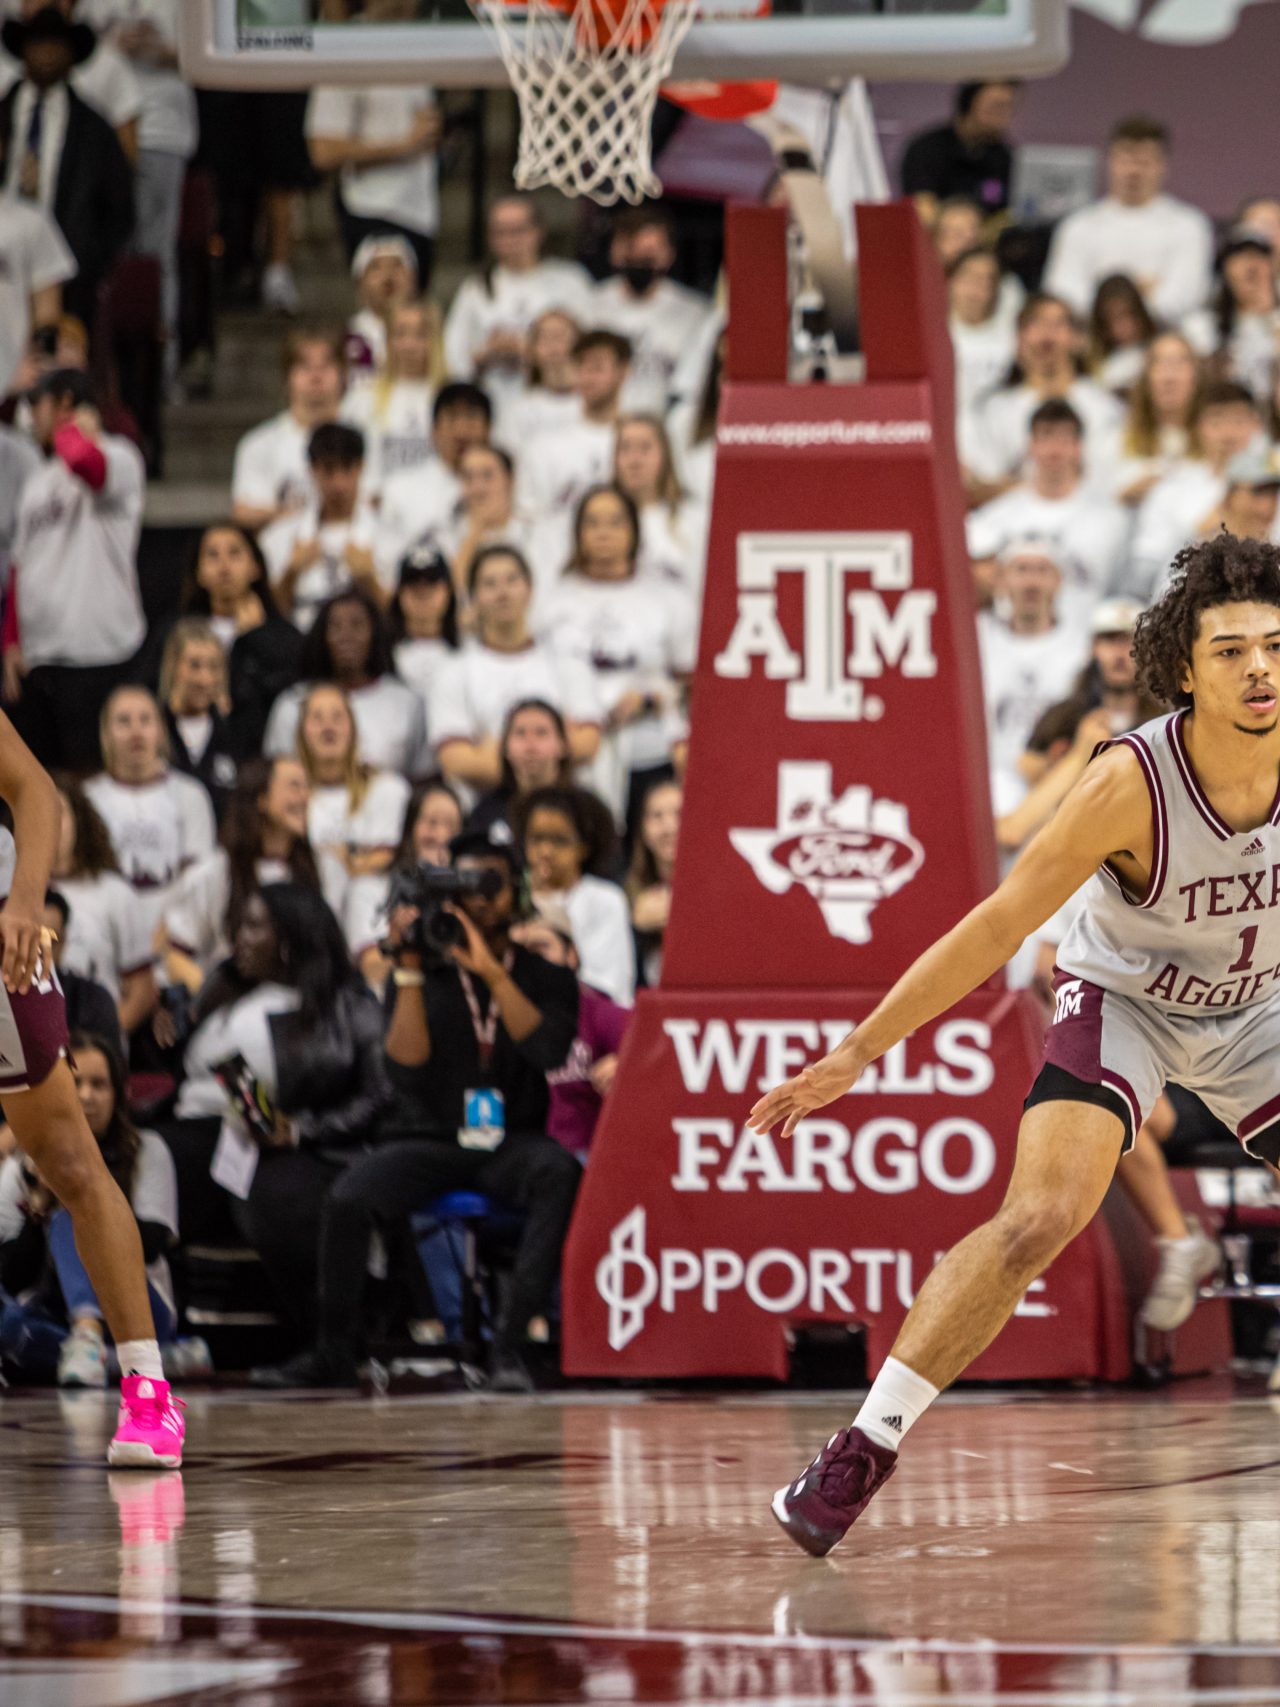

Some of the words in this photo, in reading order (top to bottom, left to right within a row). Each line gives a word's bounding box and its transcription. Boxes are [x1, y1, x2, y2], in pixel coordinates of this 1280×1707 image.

[788, 832, 902, 878] Ford
[1227, 924, 1259, 974] 1
[662, 1018, 996, 1096] WELLS
[671, 1116, 997, 1195] FARGO
